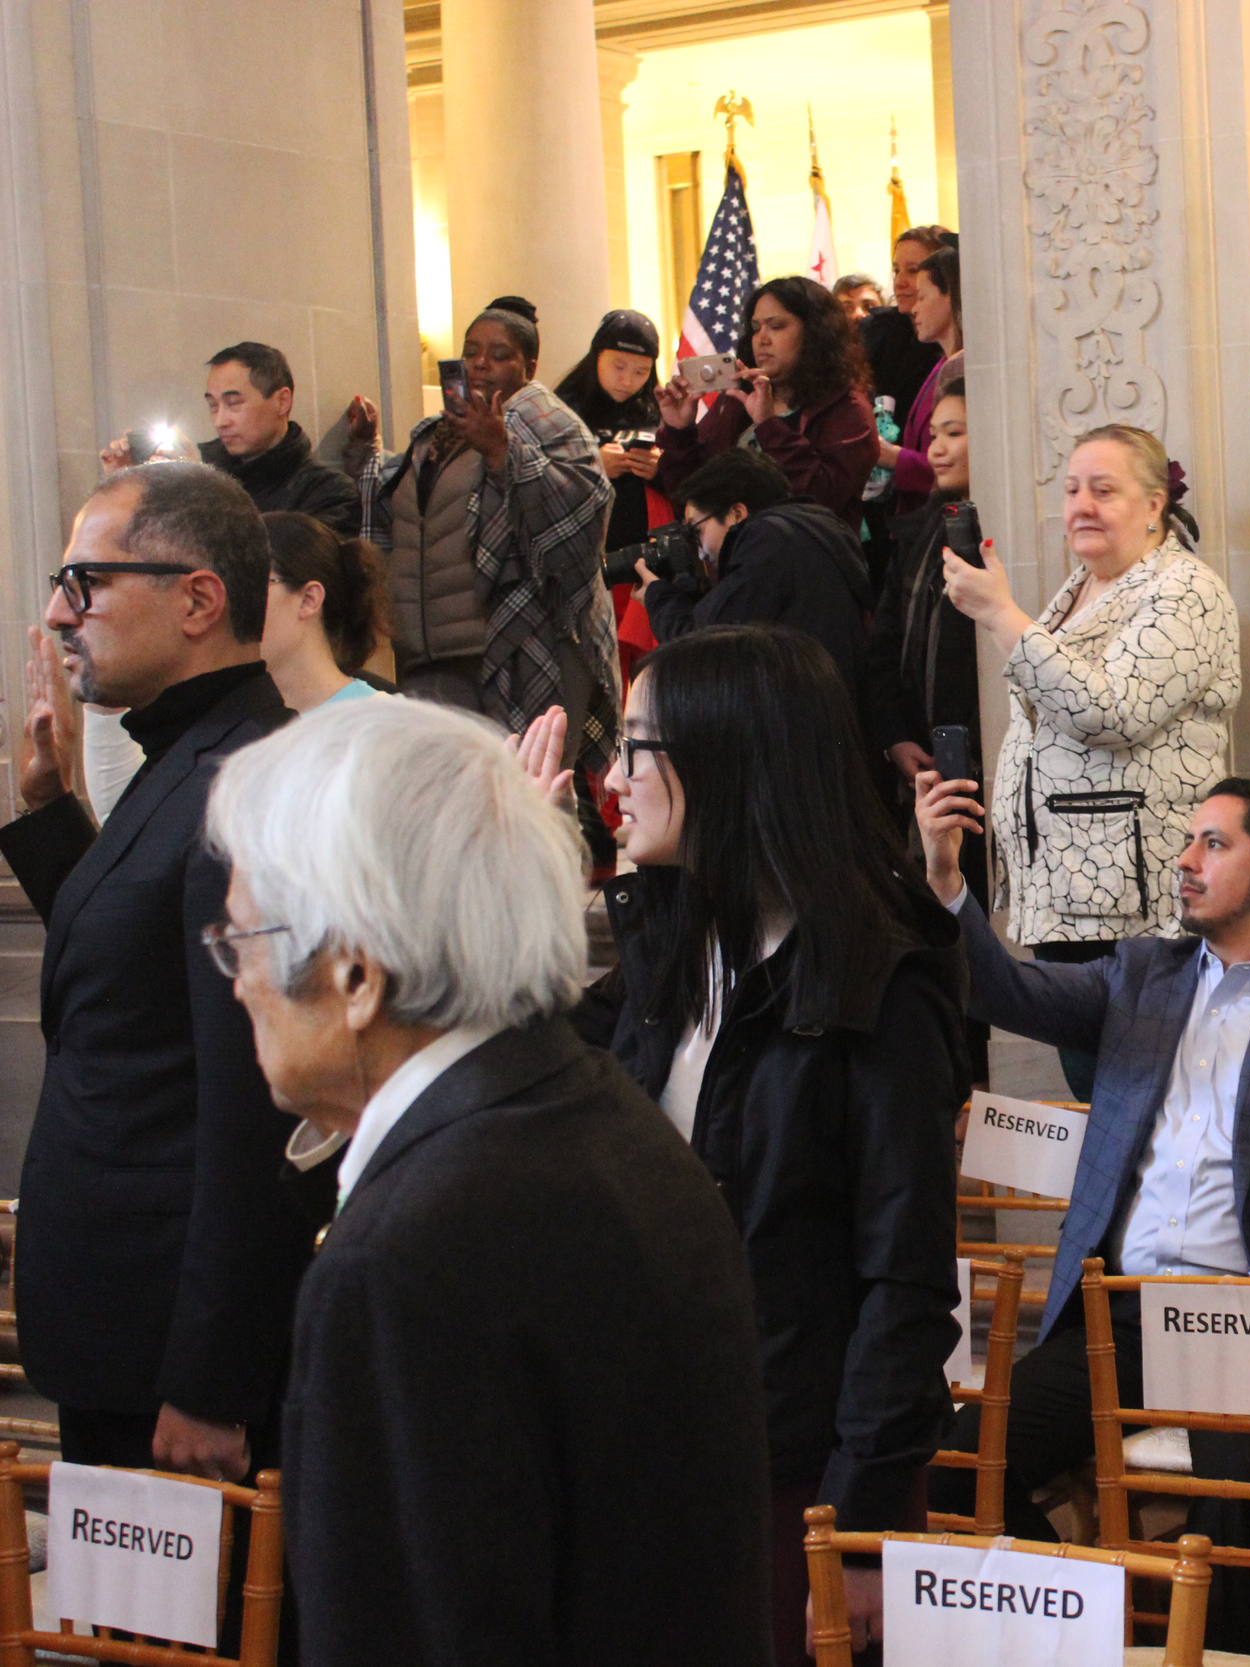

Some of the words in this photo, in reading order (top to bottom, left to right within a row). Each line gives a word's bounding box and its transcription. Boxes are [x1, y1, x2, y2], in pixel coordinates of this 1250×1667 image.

[983, 1106, 1069, 1142] RESERVED
[71, 1507, 194, 1561] RESERVED
[914, 1569, 1085, 1620] RESERVED
